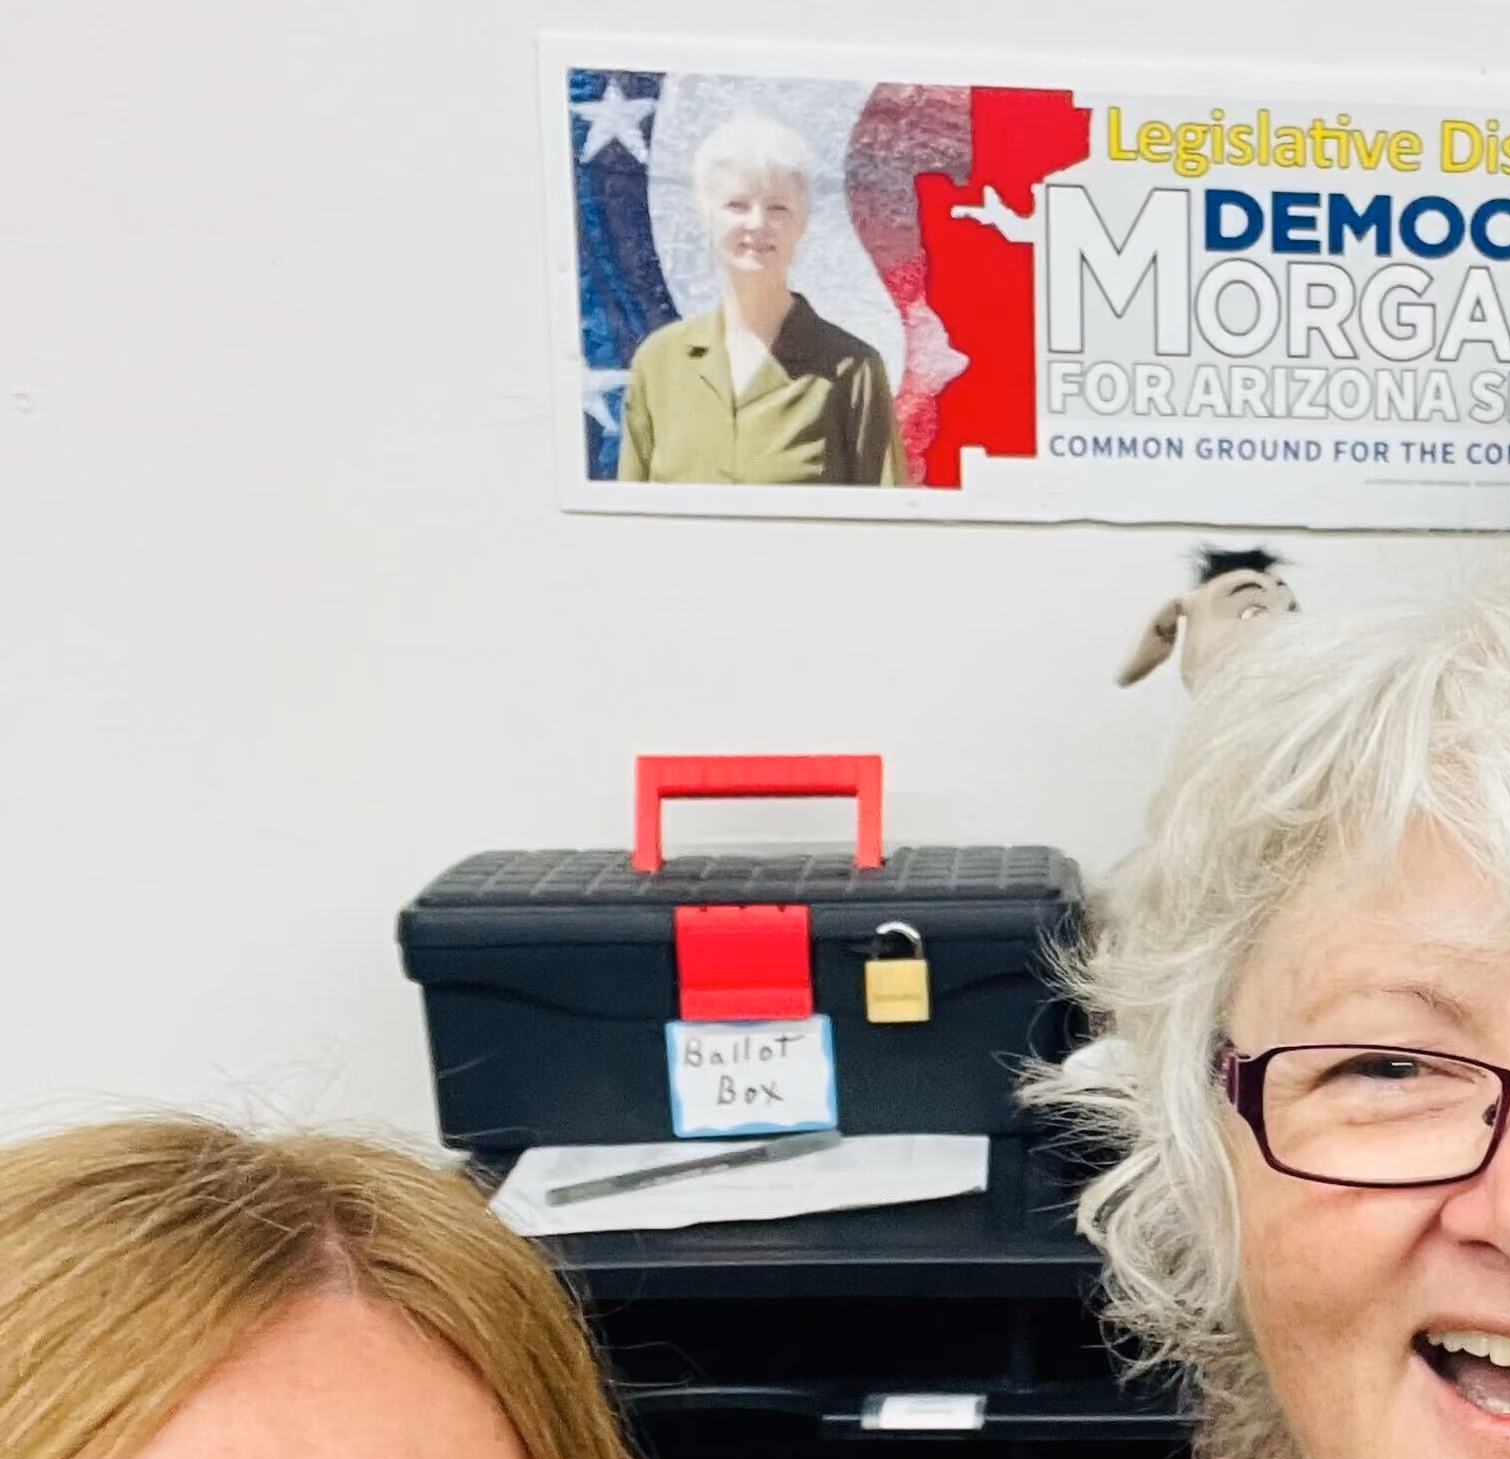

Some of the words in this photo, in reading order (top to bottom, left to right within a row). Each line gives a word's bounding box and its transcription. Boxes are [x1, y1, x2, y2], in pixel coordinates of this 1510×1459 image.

[1107, 105, 1424, 178] Legislative
[1047, 360, 1178, 417] FOR
[1184, 363, 1461, 423] ARIZONA
[1050, 434, 1185, 459] COMMON
[1195, 437, 1322, 462] GROUND
[1333, 440, 1390, 464] FOR
[1400, 441, 1455, 465] THE
[684, 1033, 806, 1068] Ballot
[716, 1074, 784, 1108] Box
